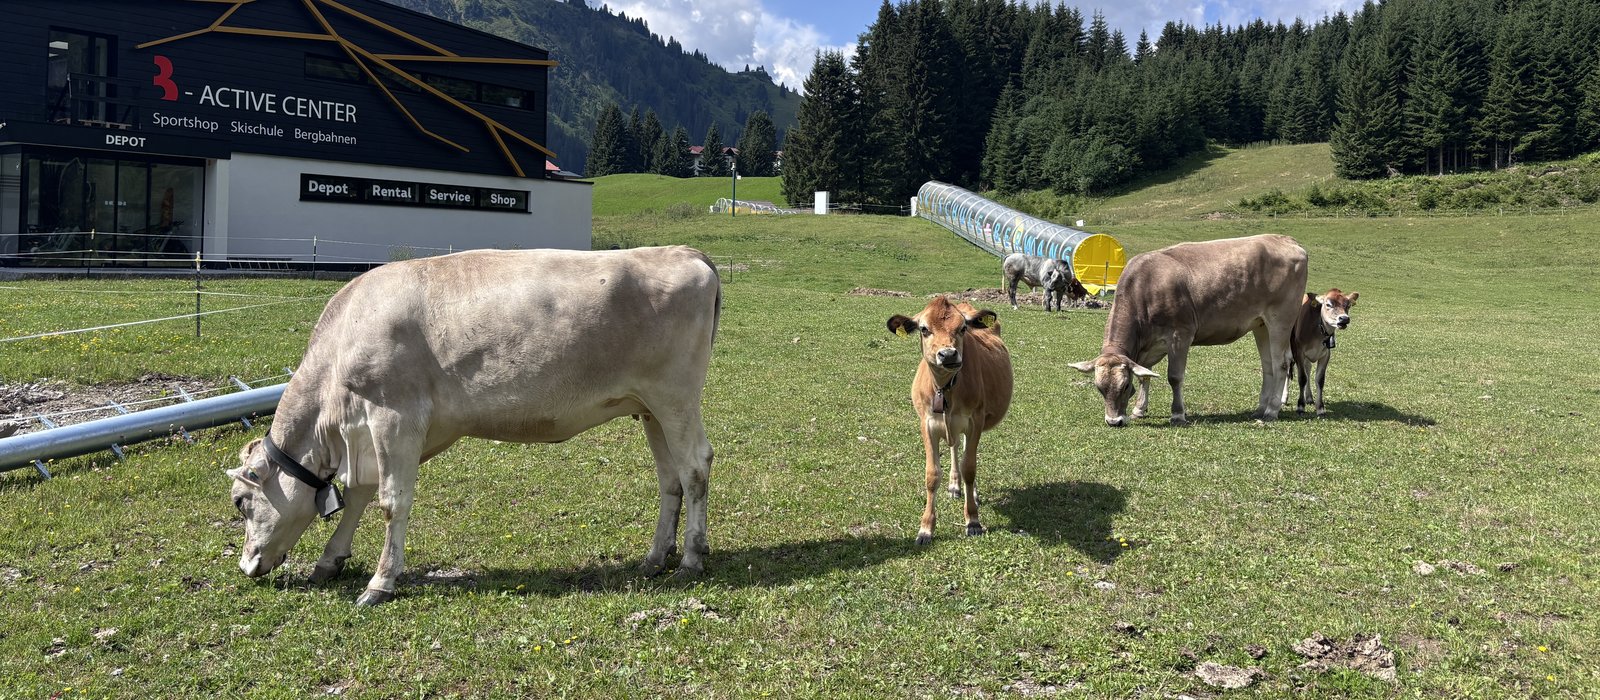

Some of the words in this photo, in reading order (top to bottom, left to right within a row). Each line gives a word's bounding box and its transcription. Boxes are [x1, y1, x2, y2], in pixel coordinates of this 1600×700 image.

[199, 85, 277, 114] ACTIVE
[282, 95, 357, 123] CENTER
[105, 134, 147, 148] DEPOT
[152, 112, 219, 132] Sportshop
[230, 120, 284, 137] Skischule
[294, 128, 357, 145] Bergbahnen
[308, 180, 348, 196] Depot
[372, 184, 412, 199] Rental
[429, 189, 471, 203] Service
[490, 193, 516, 207] Shop
